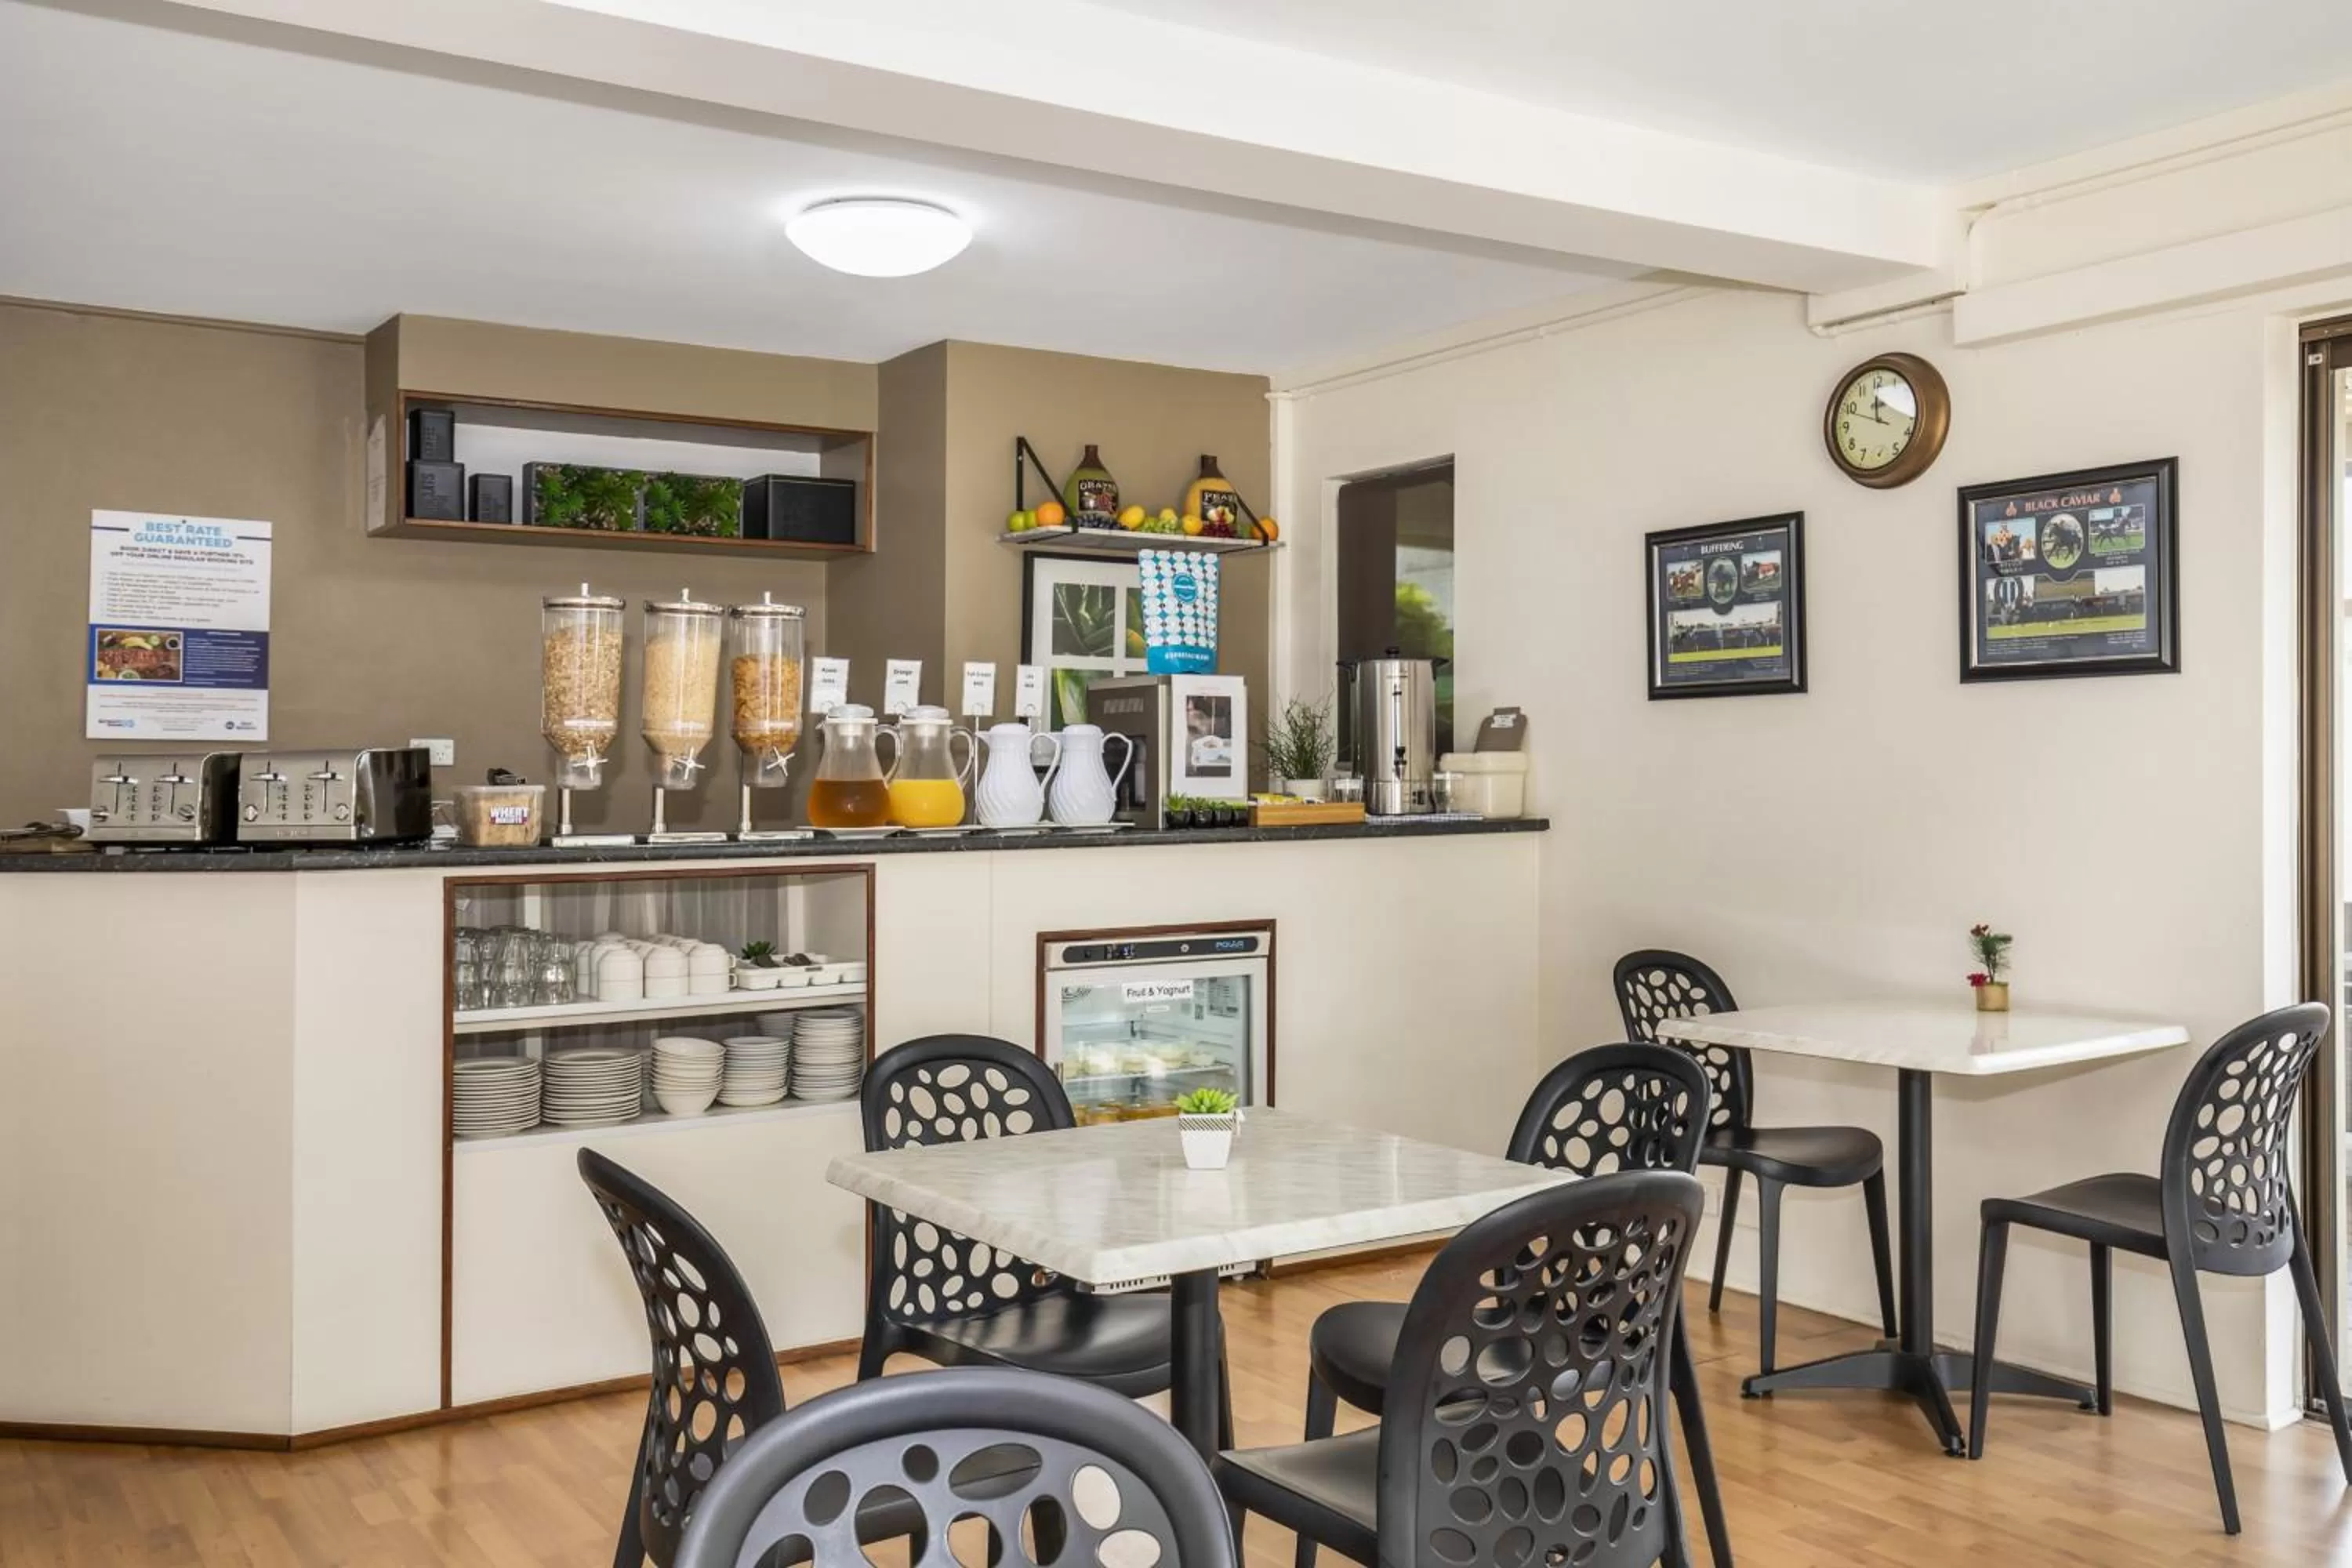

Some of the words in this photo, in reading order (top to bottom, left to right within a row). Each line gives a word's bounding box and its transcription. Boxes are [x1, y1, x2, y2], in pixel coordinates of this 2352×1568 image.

[1873, 376, 1883, 389] 12
[1859, 384, 1867, 398] 11
[1846, 401, 1857, 416] 10
[1842, 421, 1850, 434] 9
[1859, 448, 1867, 462] 7
[1892, 442, 1900, 456] 5
[2025, 498, 2058, 513] BLACK
[2060, 492, 2101, 508] CAVIAR
[145, 521, 183, 533] BEST
[186, 524, 222, 536] RATE
[133, 532, 233, 548] GUARANTEED
